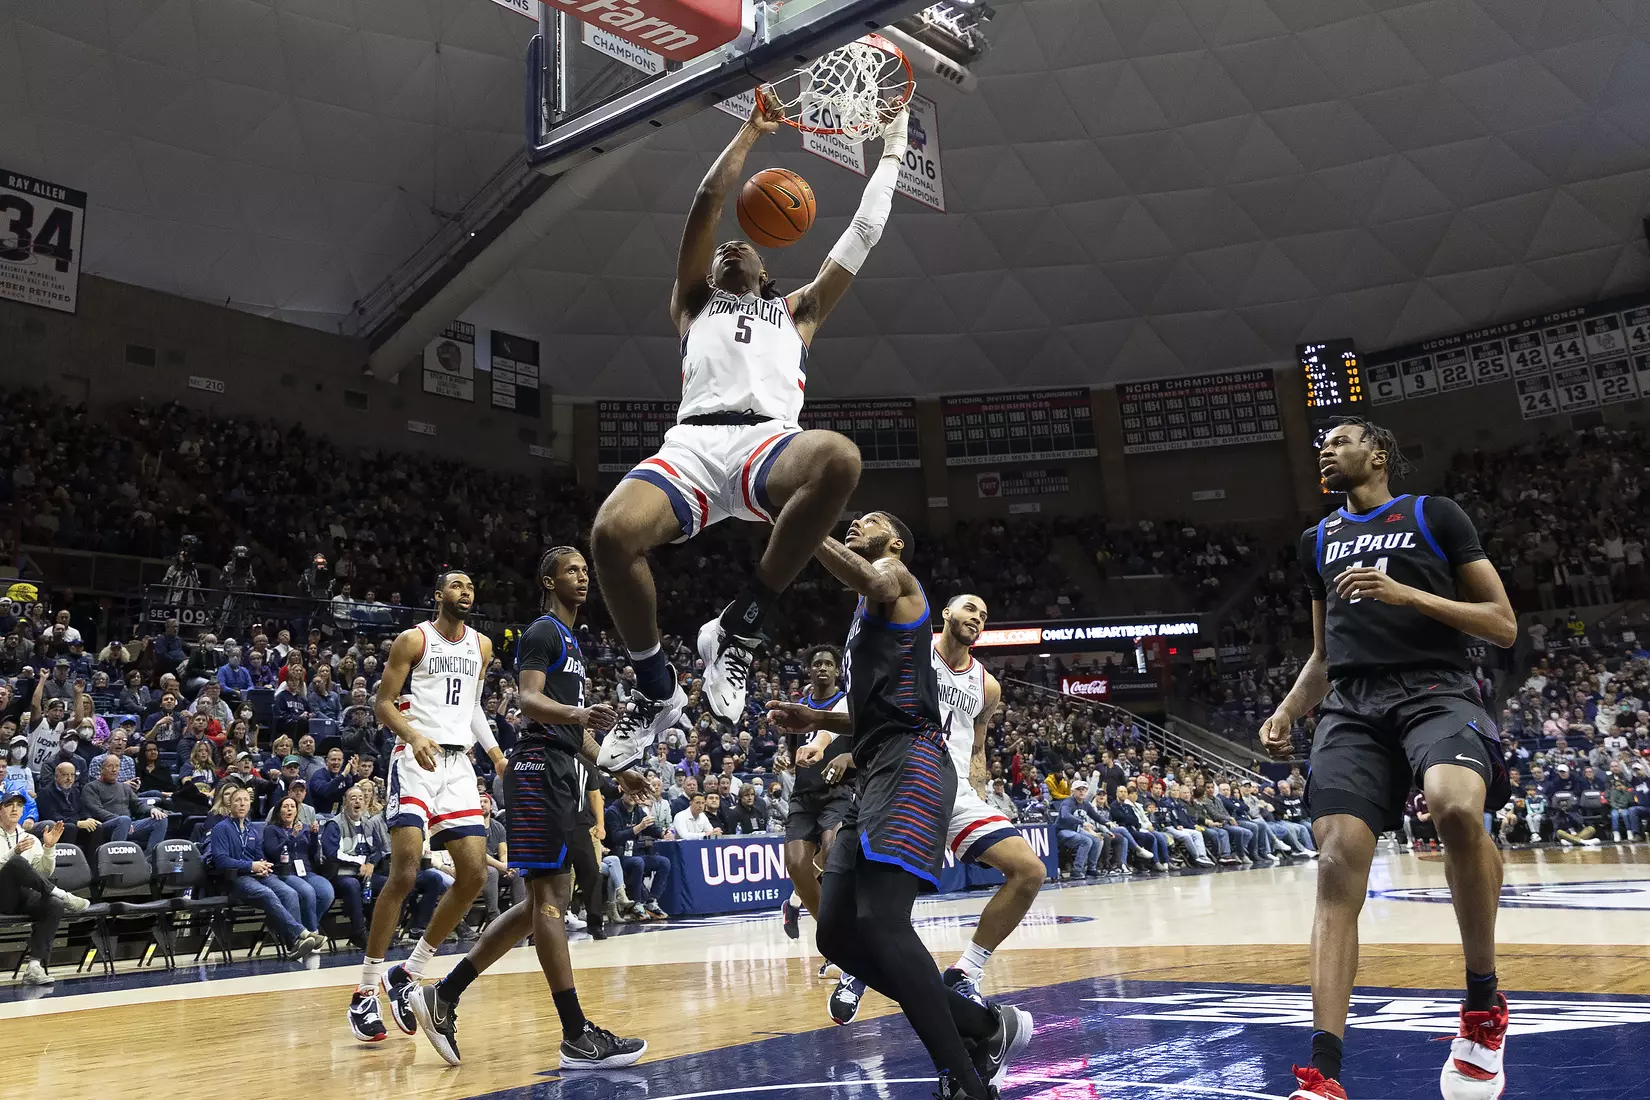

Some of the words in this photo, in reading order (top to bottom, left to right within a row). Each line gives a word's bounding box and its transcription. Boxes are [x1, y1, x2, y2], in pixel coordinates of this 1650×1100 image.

[576, 0, 699, 51] Farm
[593, 35, 656, 73] CHAMPIONS
[810, 101, 841, 128] 201
[813, 133, 855, 154] NATIONAL
[810, 140, 859, 169] CHAMPIONS
[901, 150, 936, 180] 016
[8, 175, 30, 190] RAY
[33, 182, 66, 201] ALLEN
[898, 170, 935, 192] NATIONAL
[896, 180, 940, 206] CHAMPIONS
[0, 195, 74, 272] 34
[29, 287, 71, 302] RETIRED
[734, 315, 755, 344] 5
[1422, 336, 1461, 350] UCONN
[1465, 323, 1518, 340] HUSKIES
[1522, 318, 1537, 328] OF
[1544, 307, 1586, 323] HONOR
[1633, 326, 1650, 343] 4
[1516, 349, 1542, 367] 42
[1554, 340, 1581, 359] 44
[1442, 365, 1468, 383] 22
[1477, 357, 1505, 376] 25
[205, 380, 224, 391] 210
[1125, 382, 1159, 393] NCAA
[1165, 371, 1264, 389] CHAMPIONSHIP
[1377, 381, 1393, 397] C
[1414, 374, 1425, 389] 9
[1601, 376, 1630, 396] 22
[986, 393, 1029, 403] INVITATION
[1032, 390, 1083, 400] TOURNAMENT
[1524, 391, 1552, 411] 24
[1564, 385, 1587, 403] 13
[600, 402, 621, 411] BIG
[626, 403, 657, 411] EAST
[849, 409, 903, 417] CHAMPIONS
[899, 418, 915, 428] 2011
[1053, 423, 1070, 434] 2015
[950, 455, 1007, 465] CONNECTICUT
[150, 608, 170, 619] SEC
[173, 608, 206, 624] 109
[1041, 628, 1074, 641] ONLY
[1074, 628, 1086, 639] A
[1086, 624, 1158, 639] HEARTBEAT
[1158, 623, 1199, 636] AWAY!
[1465, 646, 1486, 658] 113
[428, 656, 480, 678] CONNECTICUT
[445, 677, 462, 706] 12
[942, 709, 953, 741] 4
[36, 736, 60, 748] UCONN
[34, 748, 52, 765] 34
[55, 848, 77, 857] CONN
[107, 845, 137, 855] UCONN
[163, 844, 193, 853] UCONN
[701, 843, 790, 886] UCON
[732, 888, 779, 904] HUSKIES
